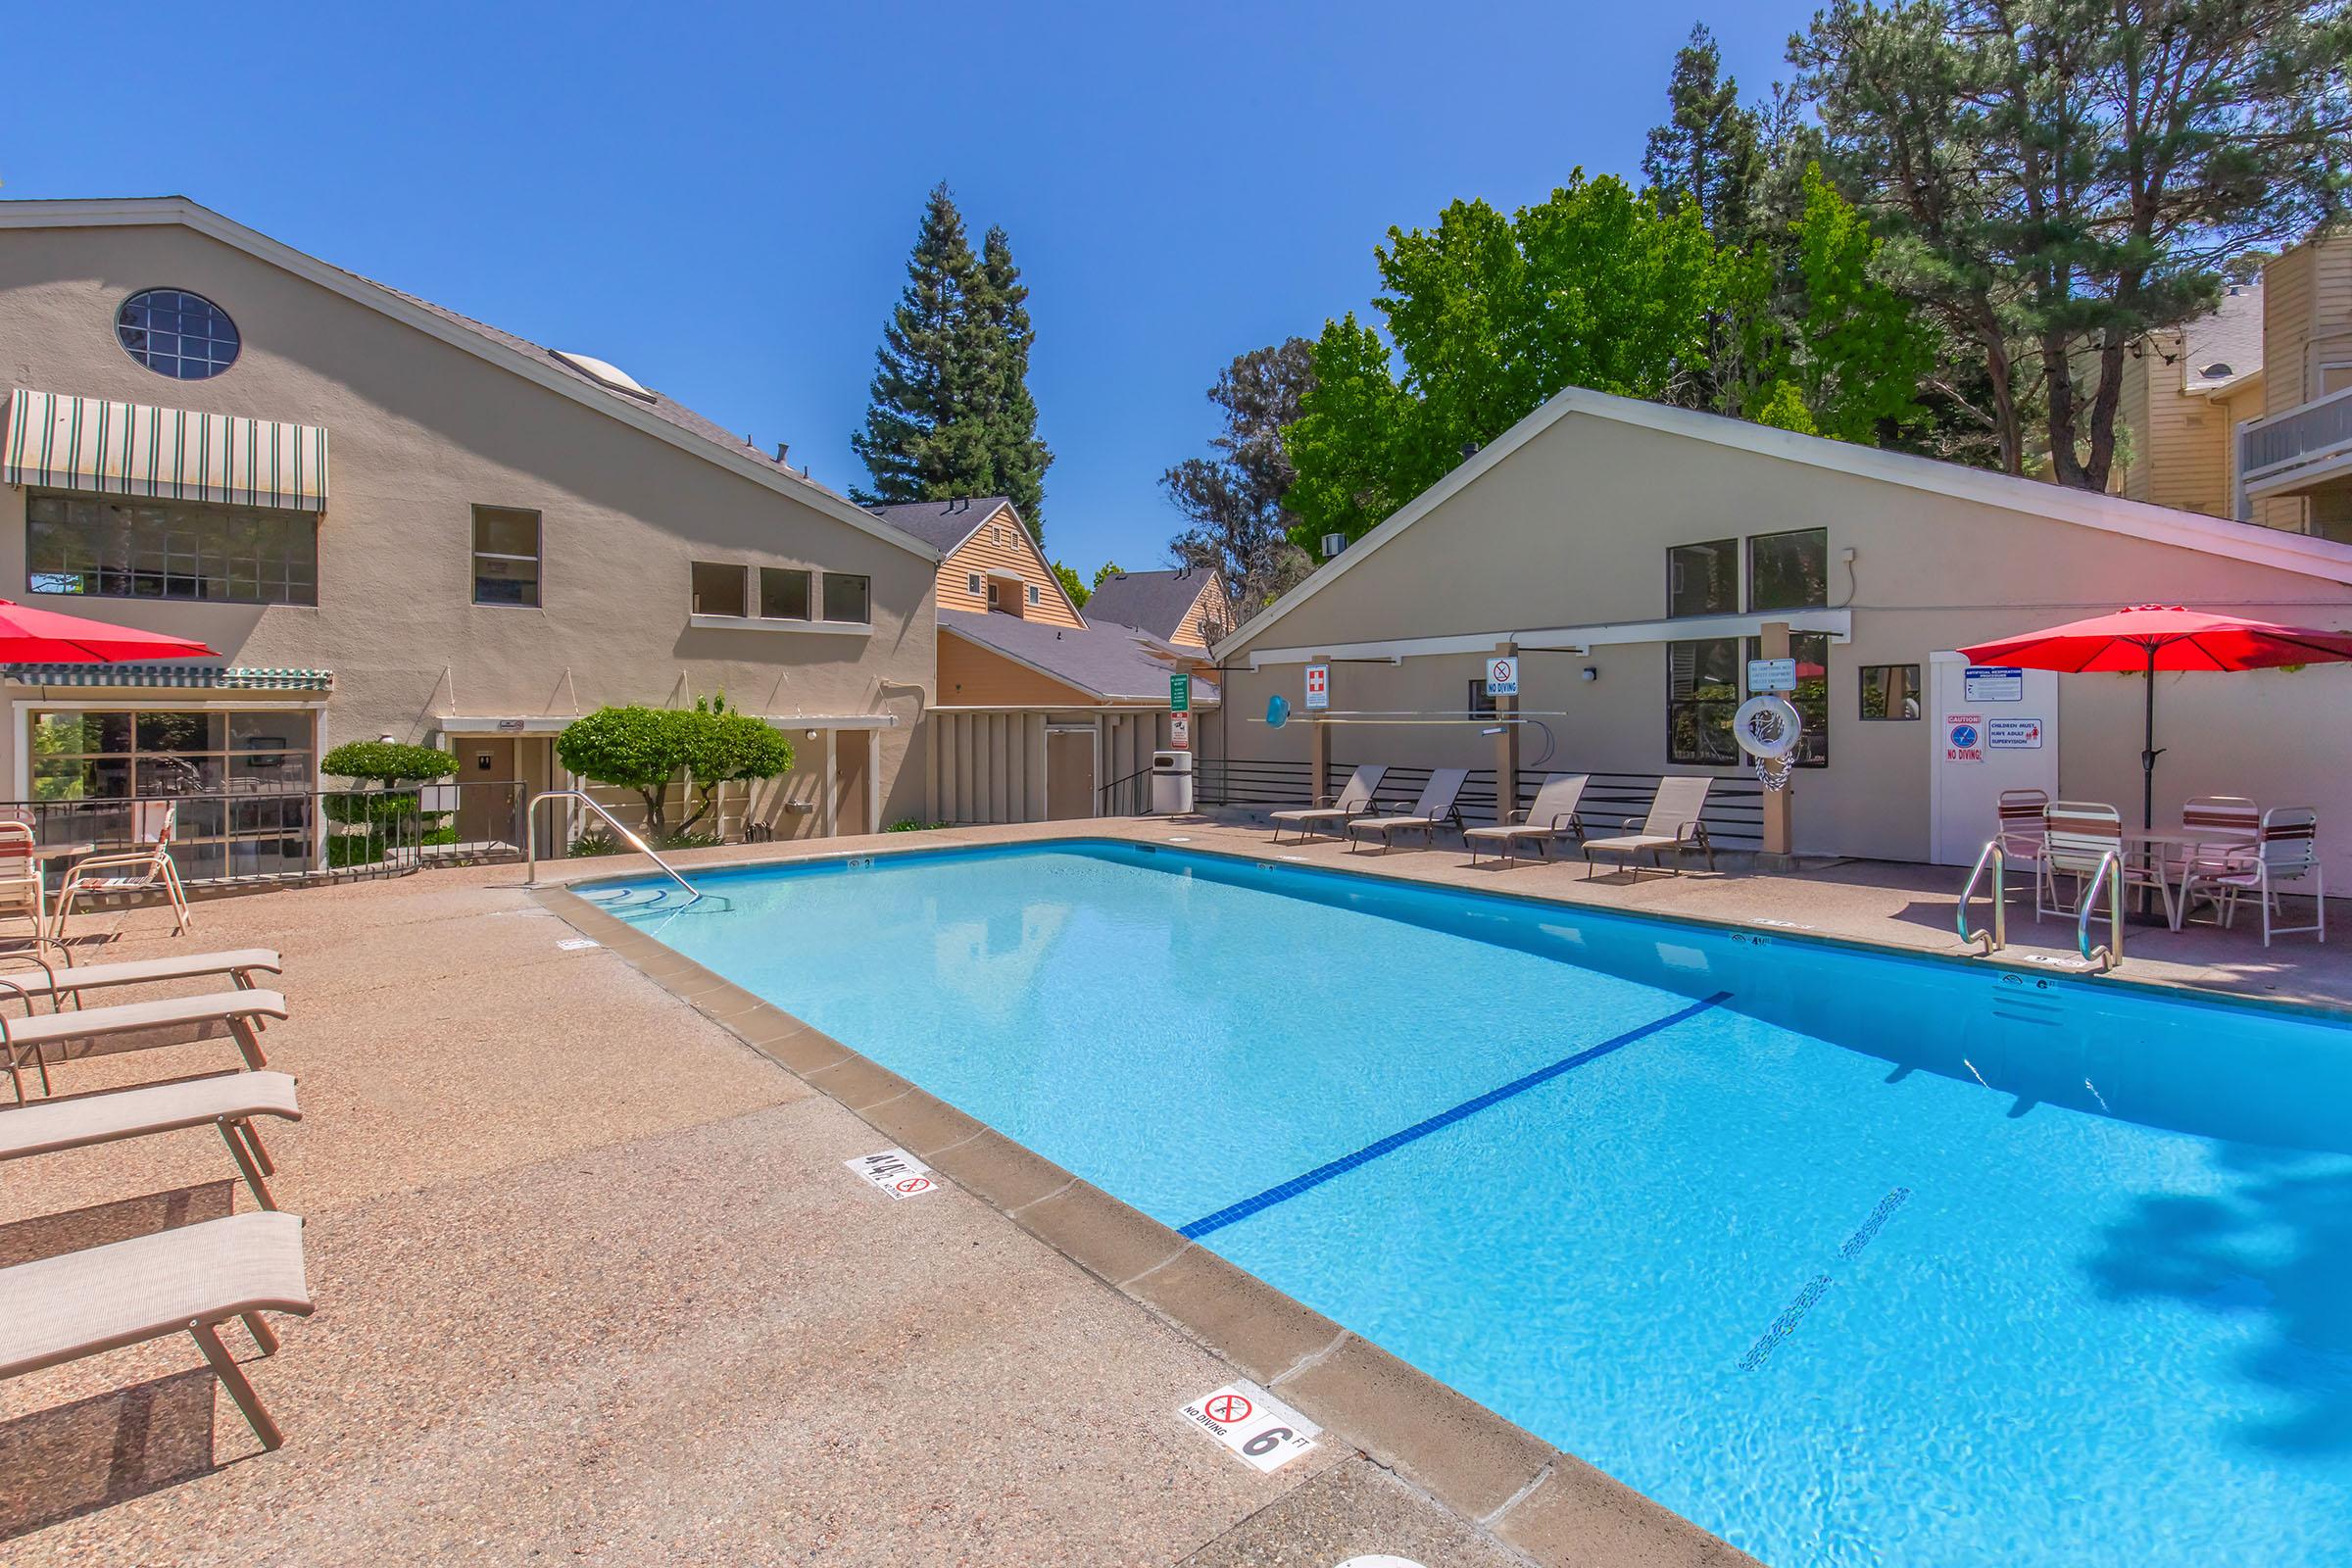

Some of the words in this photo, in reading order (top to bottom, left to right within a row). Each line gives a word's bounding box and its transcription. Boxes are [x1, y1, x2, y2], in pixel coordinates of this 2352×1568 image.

[1489, 683, 1496, 693] NO
[1497, 682, 1517, 693] DIVING
[1947, 749, 1957, 760] NO
[1184, 1405, 1200, 1417] NO
[1196, 1414, 1227, 1437] DIVING
[1242, 1427, 1294, 1456] 6
[1292, 1437, 1310, 1448] FT
